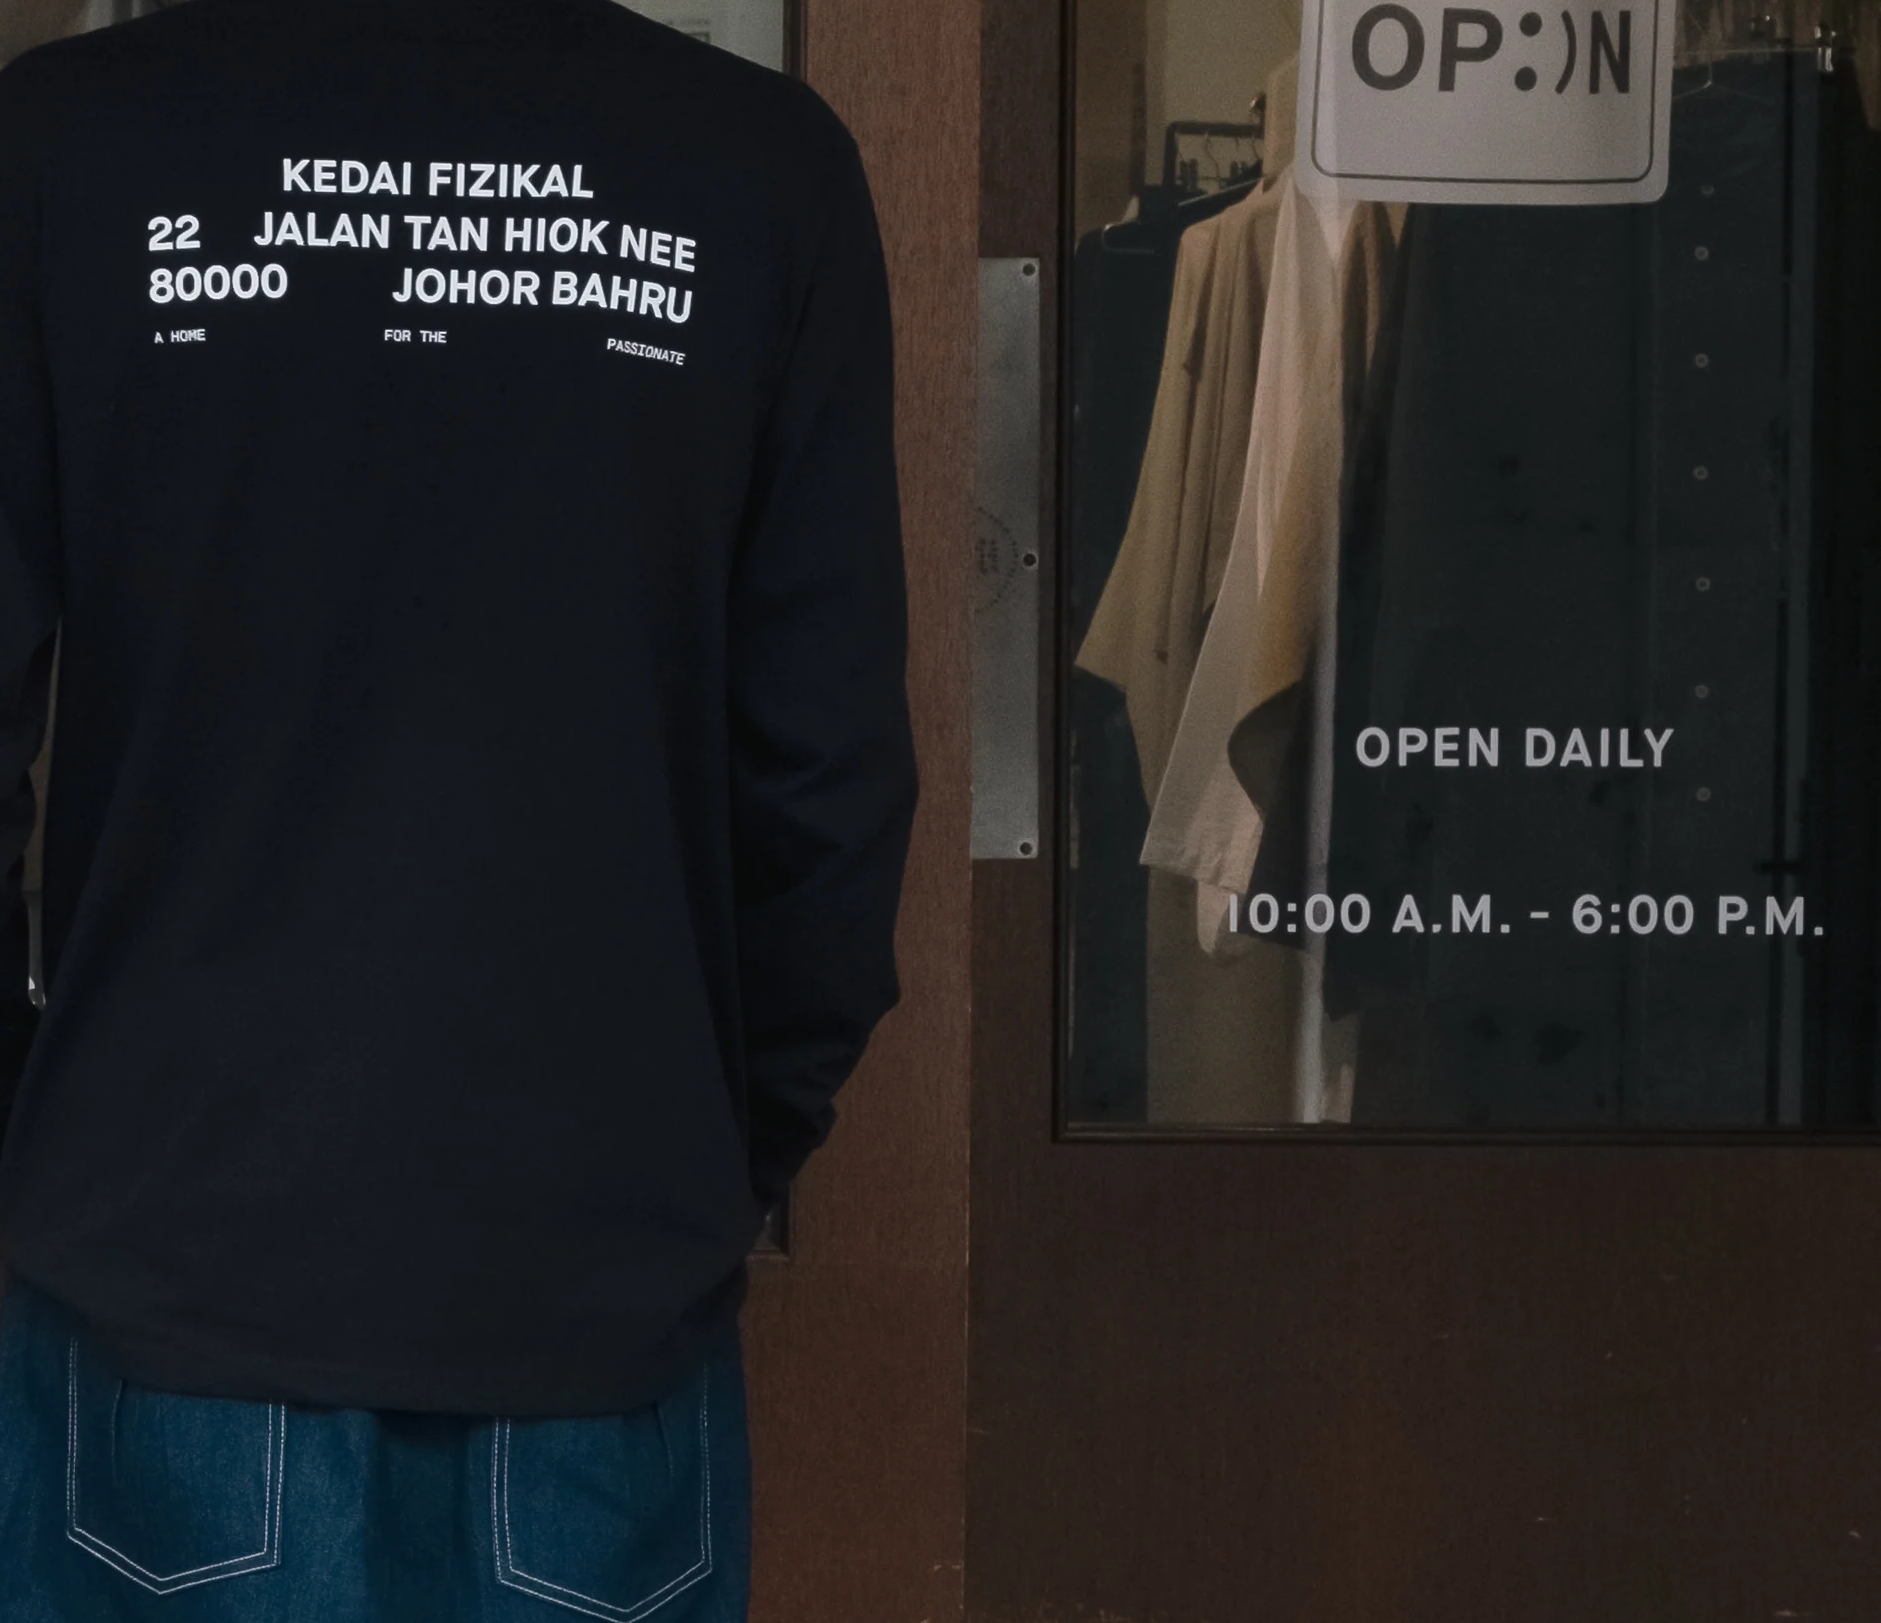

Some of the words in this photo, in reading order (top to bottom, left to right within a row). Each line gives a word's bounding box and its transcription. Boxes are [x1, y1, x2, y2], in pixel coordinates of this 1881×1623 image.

[282, 158, 412, 196] KEDAI
[428, 162, 594, 199] FIZIKAL
[147, 214, 201, 252] 22
[253, 211, 390, 249] JALAN
[403, 215, 489, 252] TAN
[504, 217, 609, 255] HIOK
[620, 224, 697, 273] NEE
[149, 263, 288, 304] 80000
[392, 267, 541, 306] JOHOR
[551, 271, 695, 324] BAHRU
[154, 331, 164, 344] A
[170, 328, 206, 343] HOME
[384, 328, 412, 342] FOR
[419, 329, 447, 344] THE
[606, 337, 686, 366] PASSIONATE
[1355, 726, 1499, 768] OPEN
[1525, 727, 1674, 768] DAILY
[1228, 892, 1372, 935] 10:00
[1392, 894, 1511, 935] A.M.
[1572, 893, 1695, 935] 6:00
[1717, 895, 1825, 936] P.M.
